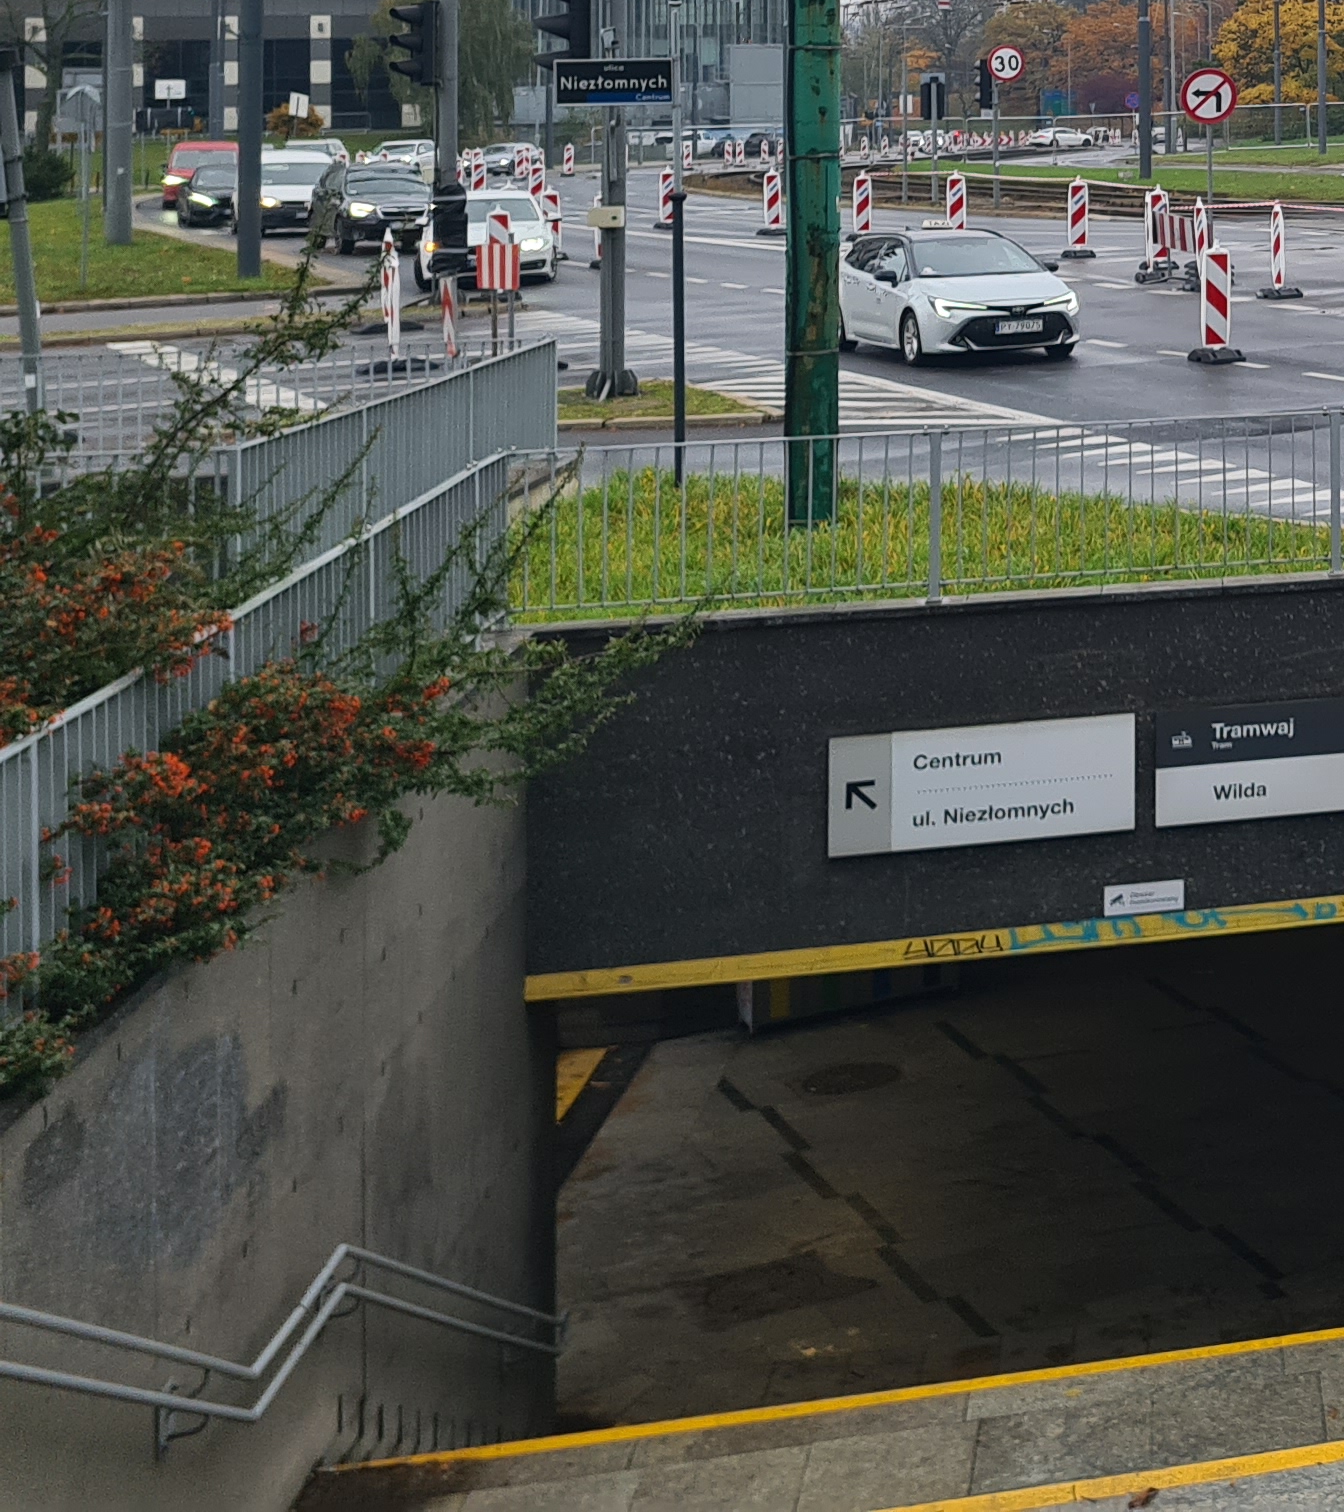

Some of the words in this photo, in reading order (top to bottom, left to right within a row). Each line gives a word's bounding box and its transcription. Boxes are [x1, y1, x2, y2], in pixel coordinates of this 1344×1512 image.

[603, 64, 625, 72] ulica
[995, 55, 1019, 72] 30
[560, 74, 667, 92] Niezłomnych
[635, 93, 671, 101] Centrum
[1211, 717, 1294, 740] Tramwaj
[1211, 741, 1233, 750] Tram
[913, 751, 1002, 770] Centrum
[1213, 782, 1267, 801] Wilda
[912, 810, 936, 827] ul.
[943, 798, 1074, 825] Niezłomnych
